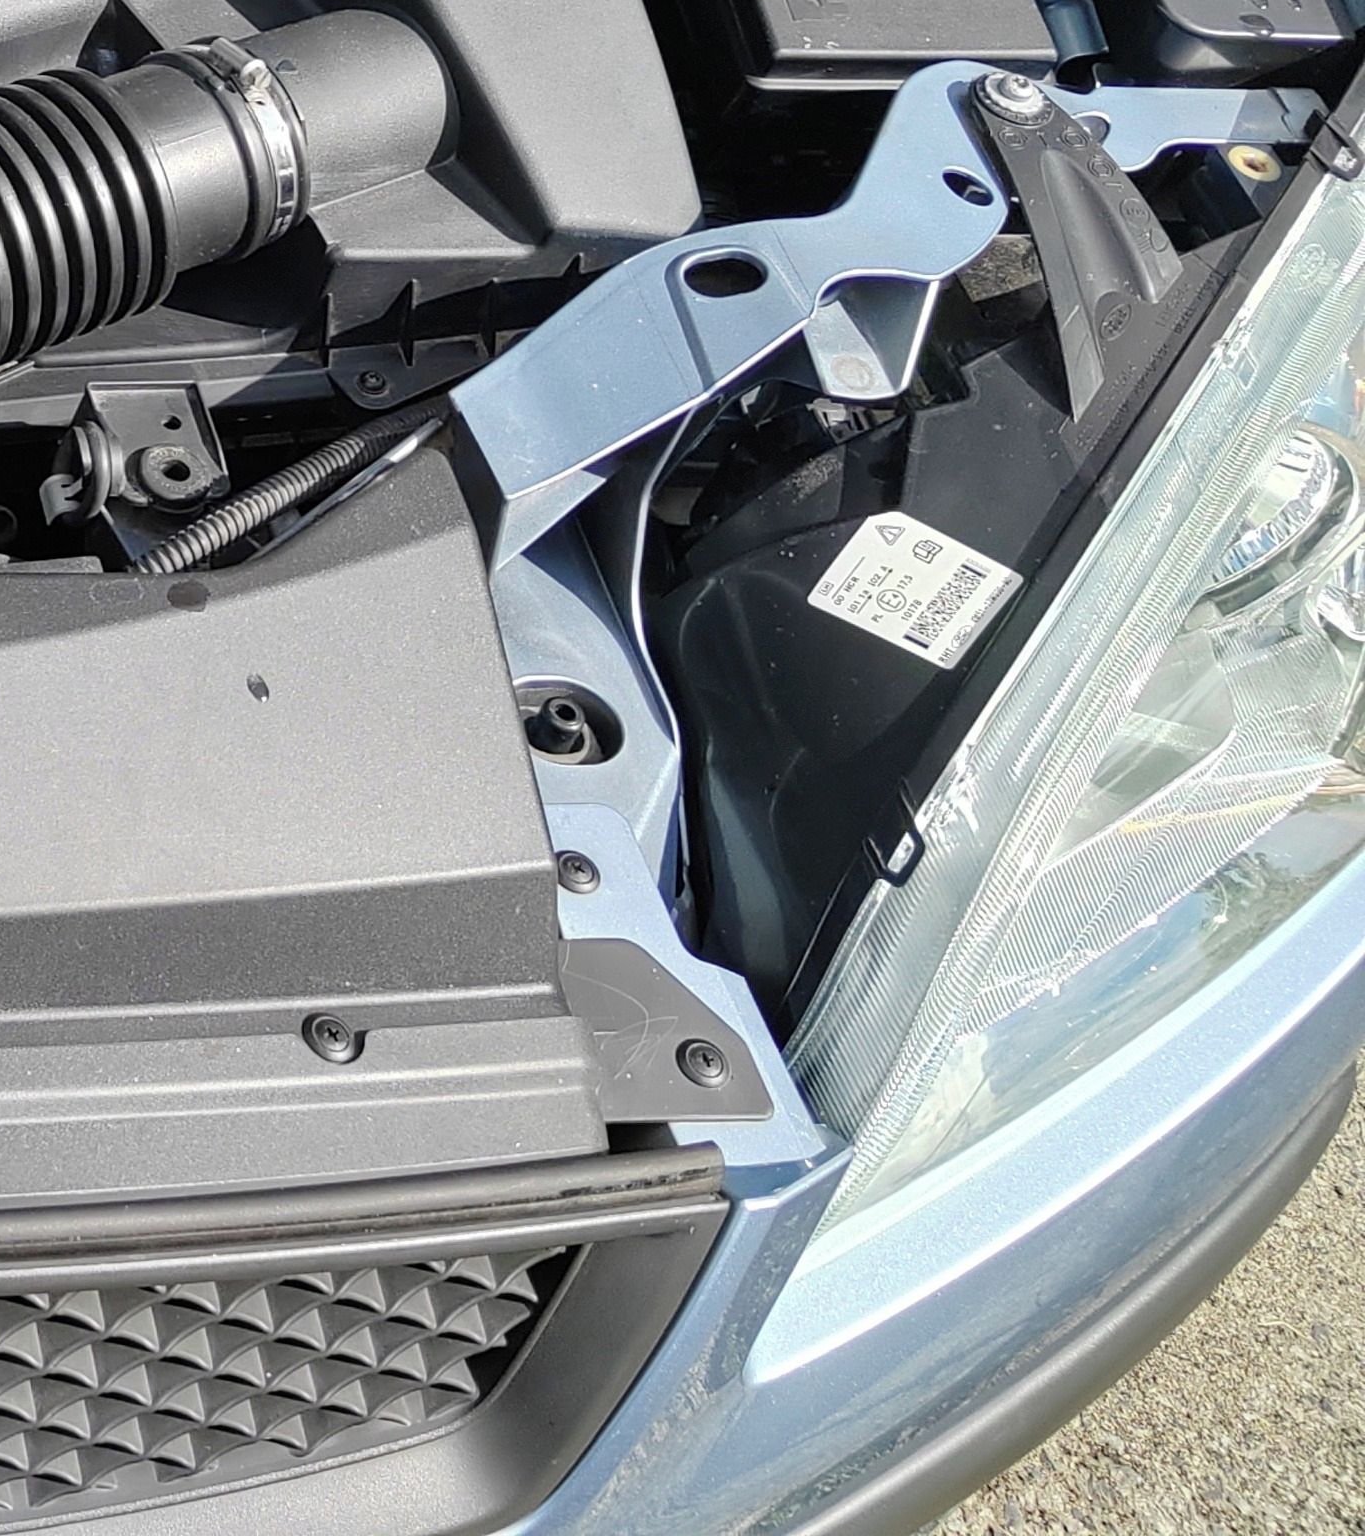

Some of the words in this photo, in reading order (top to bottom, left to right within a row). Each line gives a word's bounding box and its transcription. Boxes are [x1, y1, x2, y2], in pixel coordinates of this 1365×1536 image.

[844, 576, 860, 593] HCR
[870, 613, 884, 624] PL
[900, 599, 923, 622] 10178
